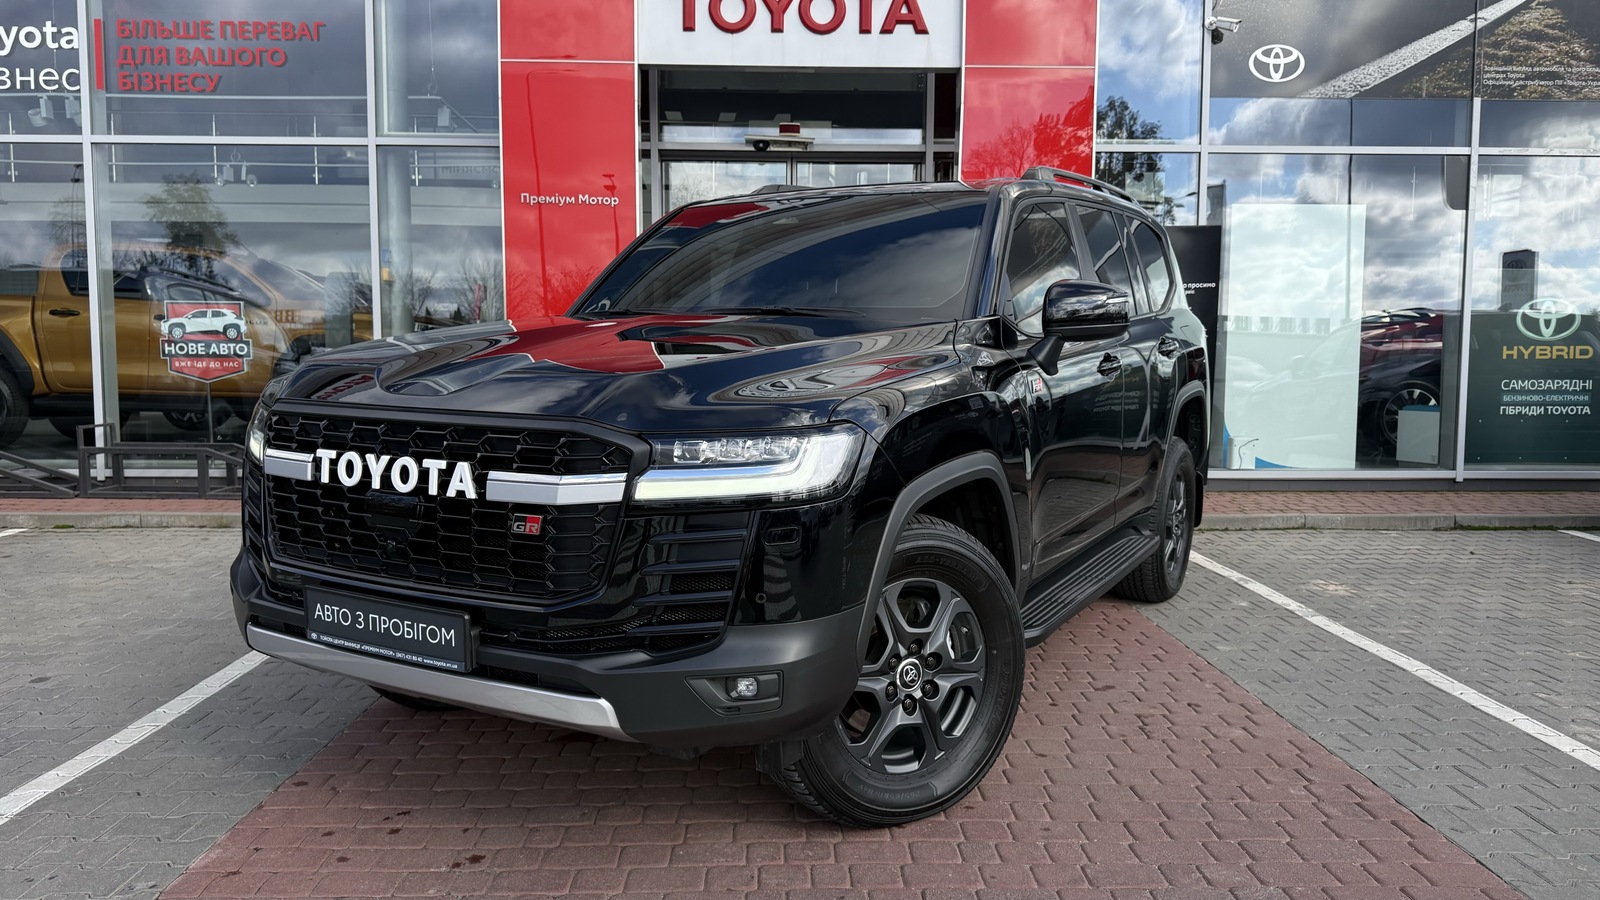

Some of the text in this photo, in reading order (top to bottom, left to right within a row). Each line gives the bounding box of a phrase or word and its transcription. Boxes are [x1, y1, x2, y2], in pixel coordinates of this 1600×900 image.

[116, 19, 325, 41] БІЛЬШЕ ПЕРЕВАГ
[116, 46, 287, 69] ДЛЯ ВАШОГО
[118, 72, 221, 93] БІЗНЕСУ
[521, 193, 619, 207] Преміум Мотор
[164, 343, 248, 355] НОВЕ АВТО
[1502, 345, 1594, 359] HYBRID
[193, 360, 207, 368] ЇДЕ
[1501, 379, 1593, 391] САМОЗАРЯДНІ
[1500, 405, 1591, 416] ГІБРИДИ TOYOTA
[316, 449, 477, 499] TOYOTA
[513, 521, 540, 534] GR
[314, 603, 351, 626] АВТО
[369, 613, 455, 647] ПРОБІГОМ
